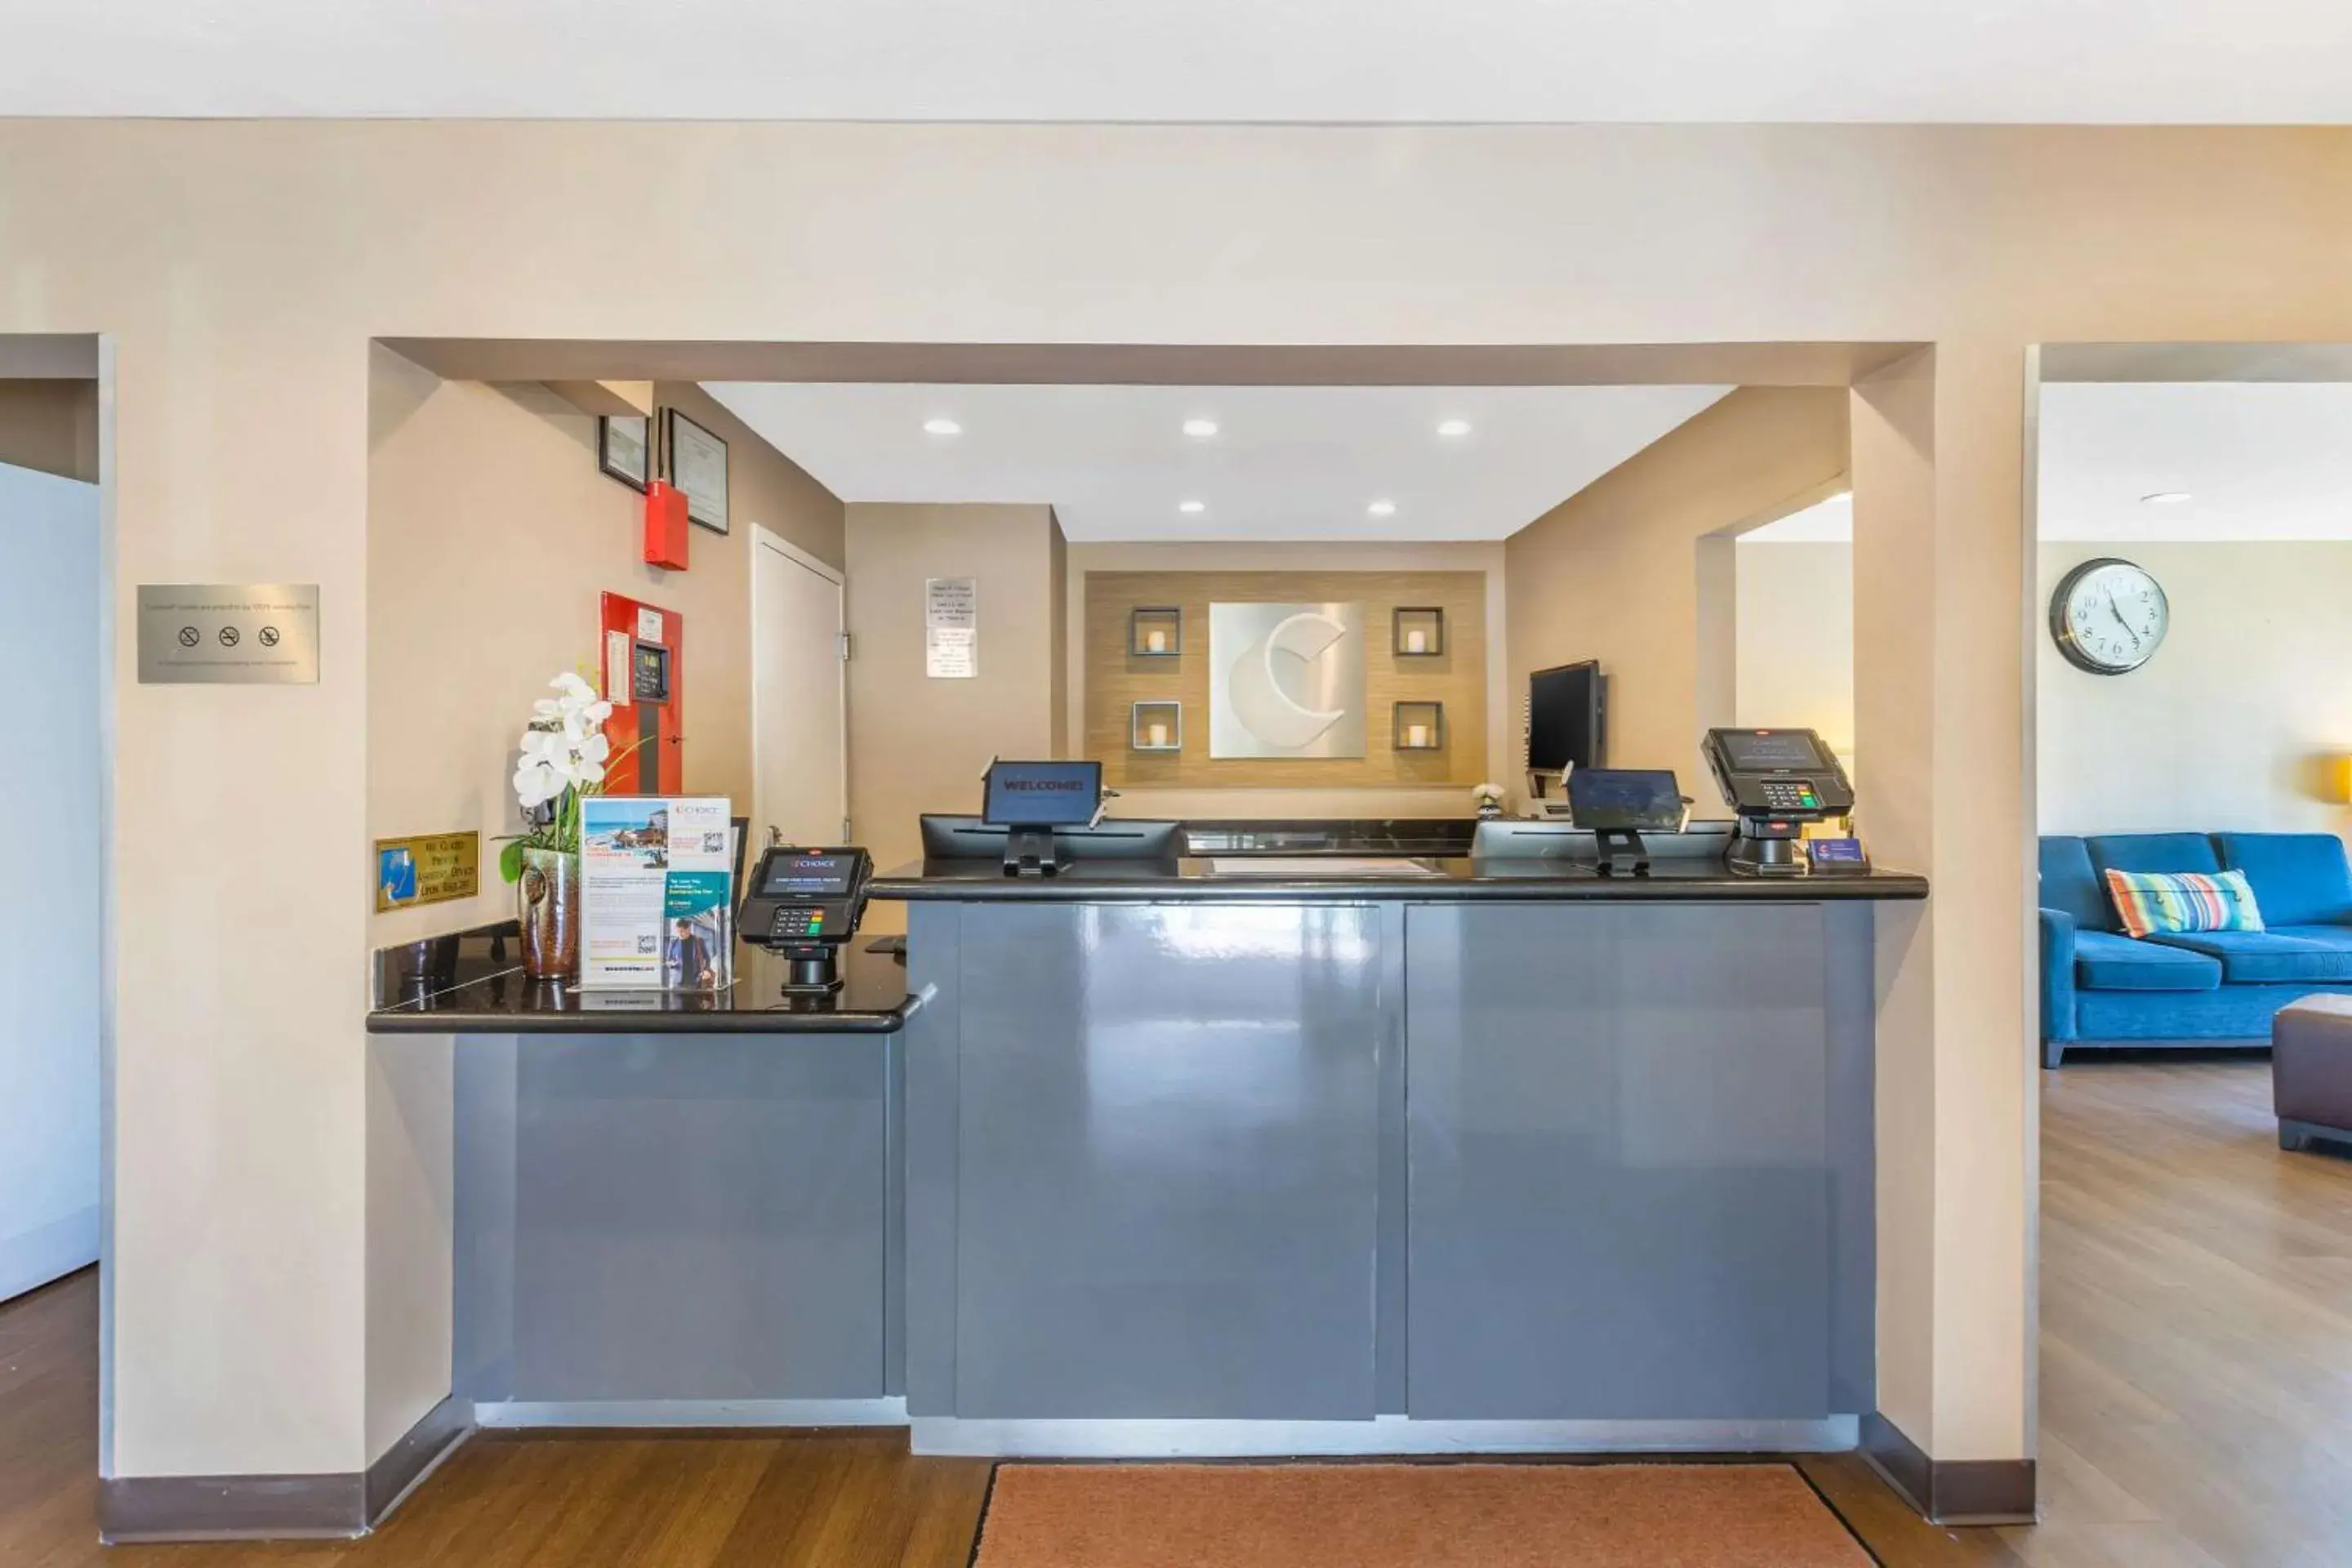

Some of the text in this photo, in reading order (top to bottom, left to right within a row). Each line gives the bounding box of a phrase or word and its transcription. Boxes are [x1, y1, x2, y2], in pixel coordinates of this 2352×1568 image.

[2084, 595, 2098, 609] 10
[2140, 590, 2150, 604] 2
[2077, 609, 2087, 621] 9
[2148, 607, 2157, 621] 3
[2083, 626, 2093, 639] 8
[2140, 624, 2154, 637] 4
[2095, 637, 2106, 653] 7
[2112, 640, 2123, 656] 6
[1004, 779, 1085, 791] WELCOME!
